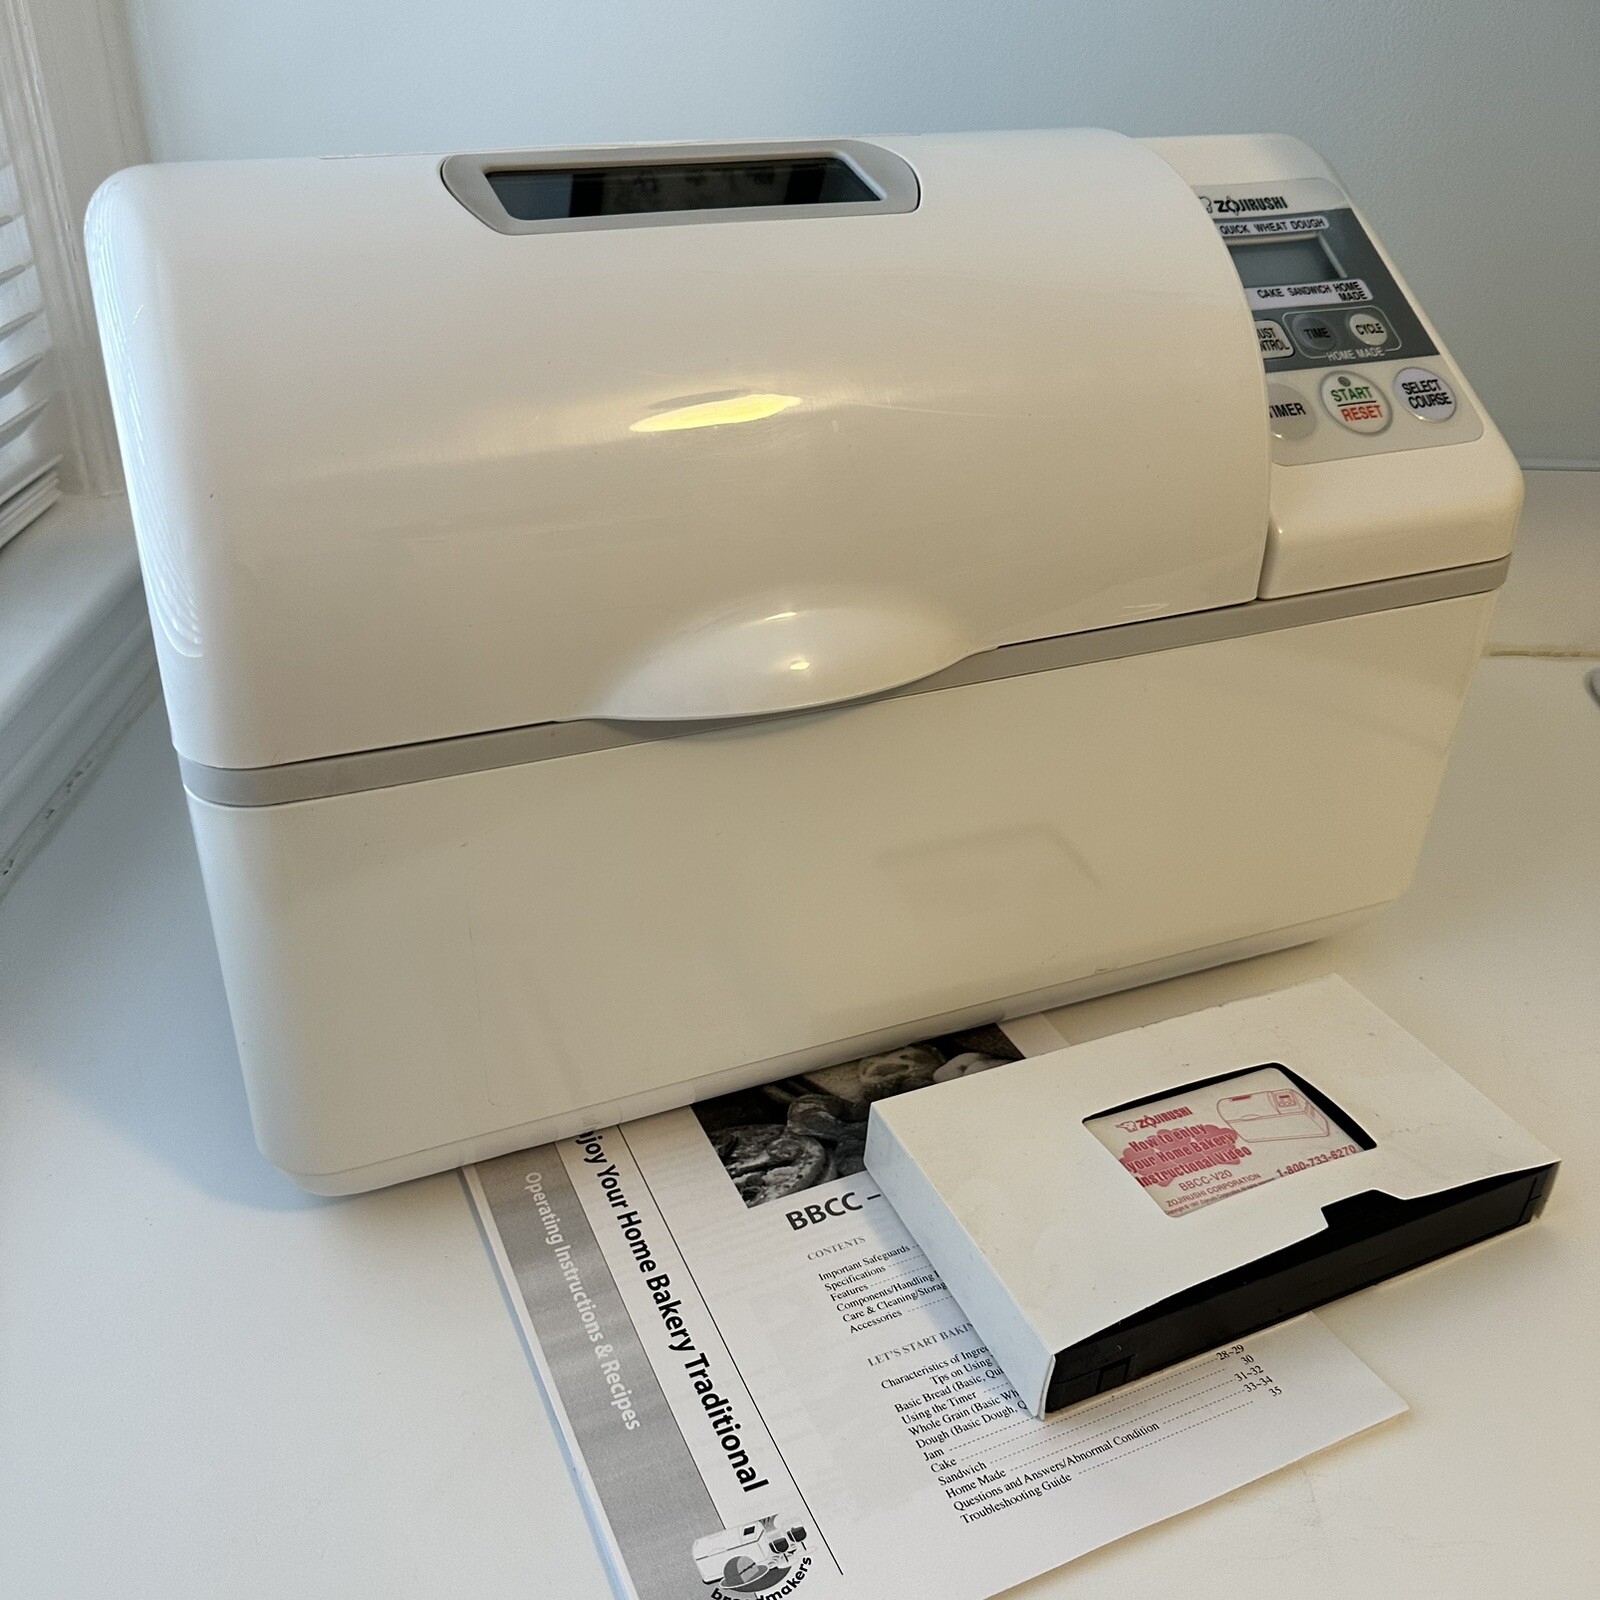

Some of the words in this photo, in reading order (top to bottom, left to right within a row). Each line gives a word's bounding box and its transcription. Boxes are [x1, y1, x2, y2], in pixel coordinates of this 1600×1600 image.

[1219, 224, 1250, 235] QUICK
[1254, 221, 1288, 233] WHEAT
[1291, 218, 1325, 230] DOUGH
[1257, 289, 1284, 299] CAKE
[1287, 285, 1331, 297] SANDWICH
[1332, 281, 1362, 292] HOME
[1338, 291, 1368, 301] MADE
[1304, 328, 1331, 340] TIME
[1356, 323, 1385, 335] CYCLE
[1326, 350, 1356, 361] HOME
[1356, 347, 1385, 358] MADE
[1330, 386, 1373, 402] START
[1401, 379, 1441, 395] SELECT
[1408, 392, 1452, 409] COURSE
[1340, 405, 1383, 422] RESET
[1128, 1139, 1159, 1153] How
[1158, 1132, 1174, 1145] to
[1173, 1124, 1207, 1140] enjoy
[1127, 1155, 1156, 1174] your
[1156, 1146, 1193, 1163] Home
[1190, 1133, 1236, 1153] Bakery
[1135, 1155, 1217, 1188] Instructional
[1214, 1146, 1252, 1163] Video
[1276, 1144, 1357, 1179] 1-800-733-6270
[1166, 1190, 1207, 1207] ZOJIRUSHI
[1206, 1173, 1262, 1194] CORPORATION
[1178, 1169, 1233, 1191] BBCC-V20
[525, 1171, 564, 1246] Operating
[785, 1191, 864, 1231] BBCC
[807, 1235, 866, 1261] CONTENTS
[818, 1260, 862, 1281] Important
[862, 1244, 911, 1267] Safeguards
[824, 1264, 887, 1292] Specifications
[830, 1282, 869, 1302] Features
[554, 1244, 604, 1343] Instructions
[836, 1273, 935, 1313] Components/Handling
[842, 1308, 865, 1323] Care
[866, 1305, 876, 1315] &
[876, 1281, 947, 1311] Cleaning/Storag
[575, 1130, 607, 1164] joy
[596, 1164, 628, 1208] Your
[617, 1210, 657, 1273] Home
[646, 1273, 696, 1351] Bakery
[684, 1352, 770, 1493] Traditional
[849, 1309, 903, 1334] Accessories
[594, 1344, 614, 1359] &
[867, 1349, 902, 1367] LET'S
[901, 1335, 938, 1354] START
[1241, 1354, 1255, 1366] 30
[881, 1359, 949, 1390] Characteristics
[950, 1353, 961, 1365] of
[951, 1368, 963, 1378] on
[963, 1358, 993, 1373] Using
[600, 1359, 641, 1432] Recipes
[894, 1397, 922, 1413] Basic
[922, 1387, 952, 1403] Bread
[951, 1374, 986, 1392] (Basic,
[1268, 1386, 1283, 1398] 35
[901, 1409, 932, 1425] Using
[932, 1401, 948, 1412] the
[949, 1391, 977, 1407] Timer
[908, 1419, 942, 1437] Whole
[942, 1409, 970, 1423] Grain
[970, 1396, 1001, 1413] (Basic
[915, 1431, 950, 1450] Dough
[950, 1422, 981, 1440] (Basic
[980, 1406, 1018, 1424] Dough,
[922, 1448, 945, 1462] Jam
[930, 1457, 957, 1474] Cake
[953, 1486, 1004, 1512] Questions
[1004, 1477, 1024, 1491] and
[1023, 1440, 1113, 1484] Answers/Abnormal
[1112, 1422, 1161, 1447] Condition
[937, 1460, 988, 1487] Sandwich
[945, 1482, 977, 1499] Home
[978, 1468, 1007, 1486] Made
[959, 1485, 1043, 1524] Troubleshooting
[1041, 1472, 1073, 1491] Guide
